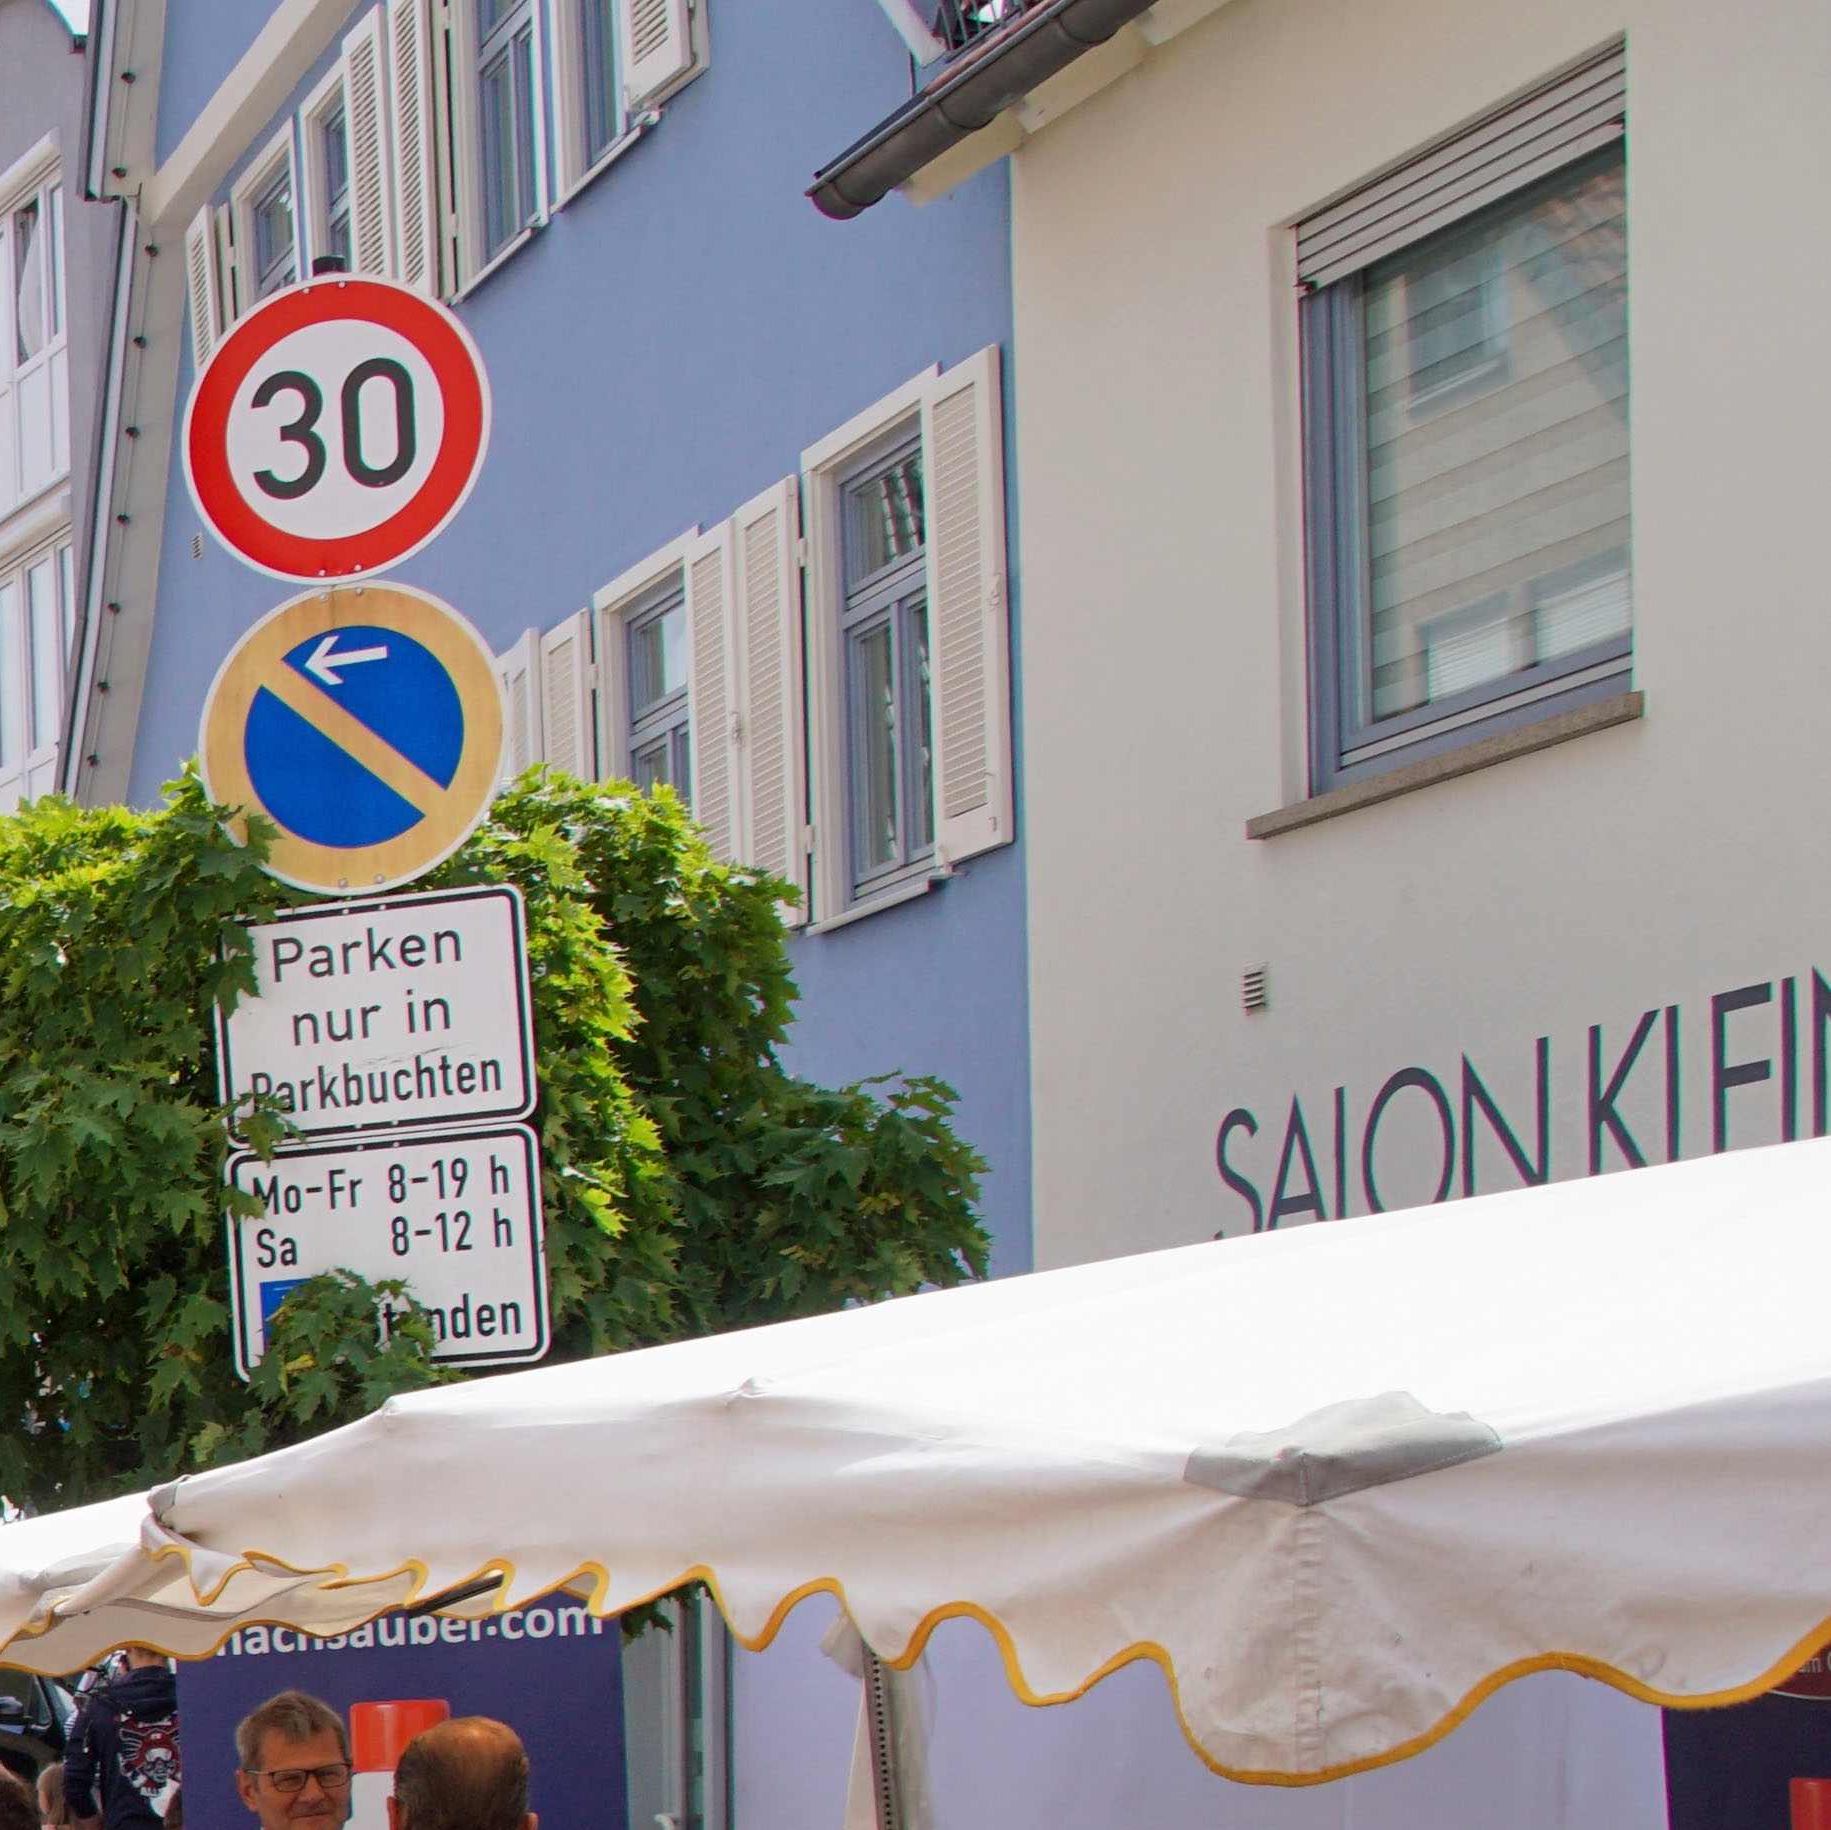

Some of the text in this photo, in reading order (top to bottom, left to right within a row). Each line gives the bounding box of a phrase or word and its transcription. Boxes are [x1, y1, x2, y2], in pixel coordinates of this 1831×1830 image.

[251, 357, 416, 500] 30
[272, 927, 462, 982] Parken
[293, 989, 451, 1046] nur in
[251, 1055, 502, 1113] Parkbuchten
[253, 1154, 509, 1215] Mo-Fr 8-19 h
[256, 1207, 513, 1268] Sa 8-12 h
